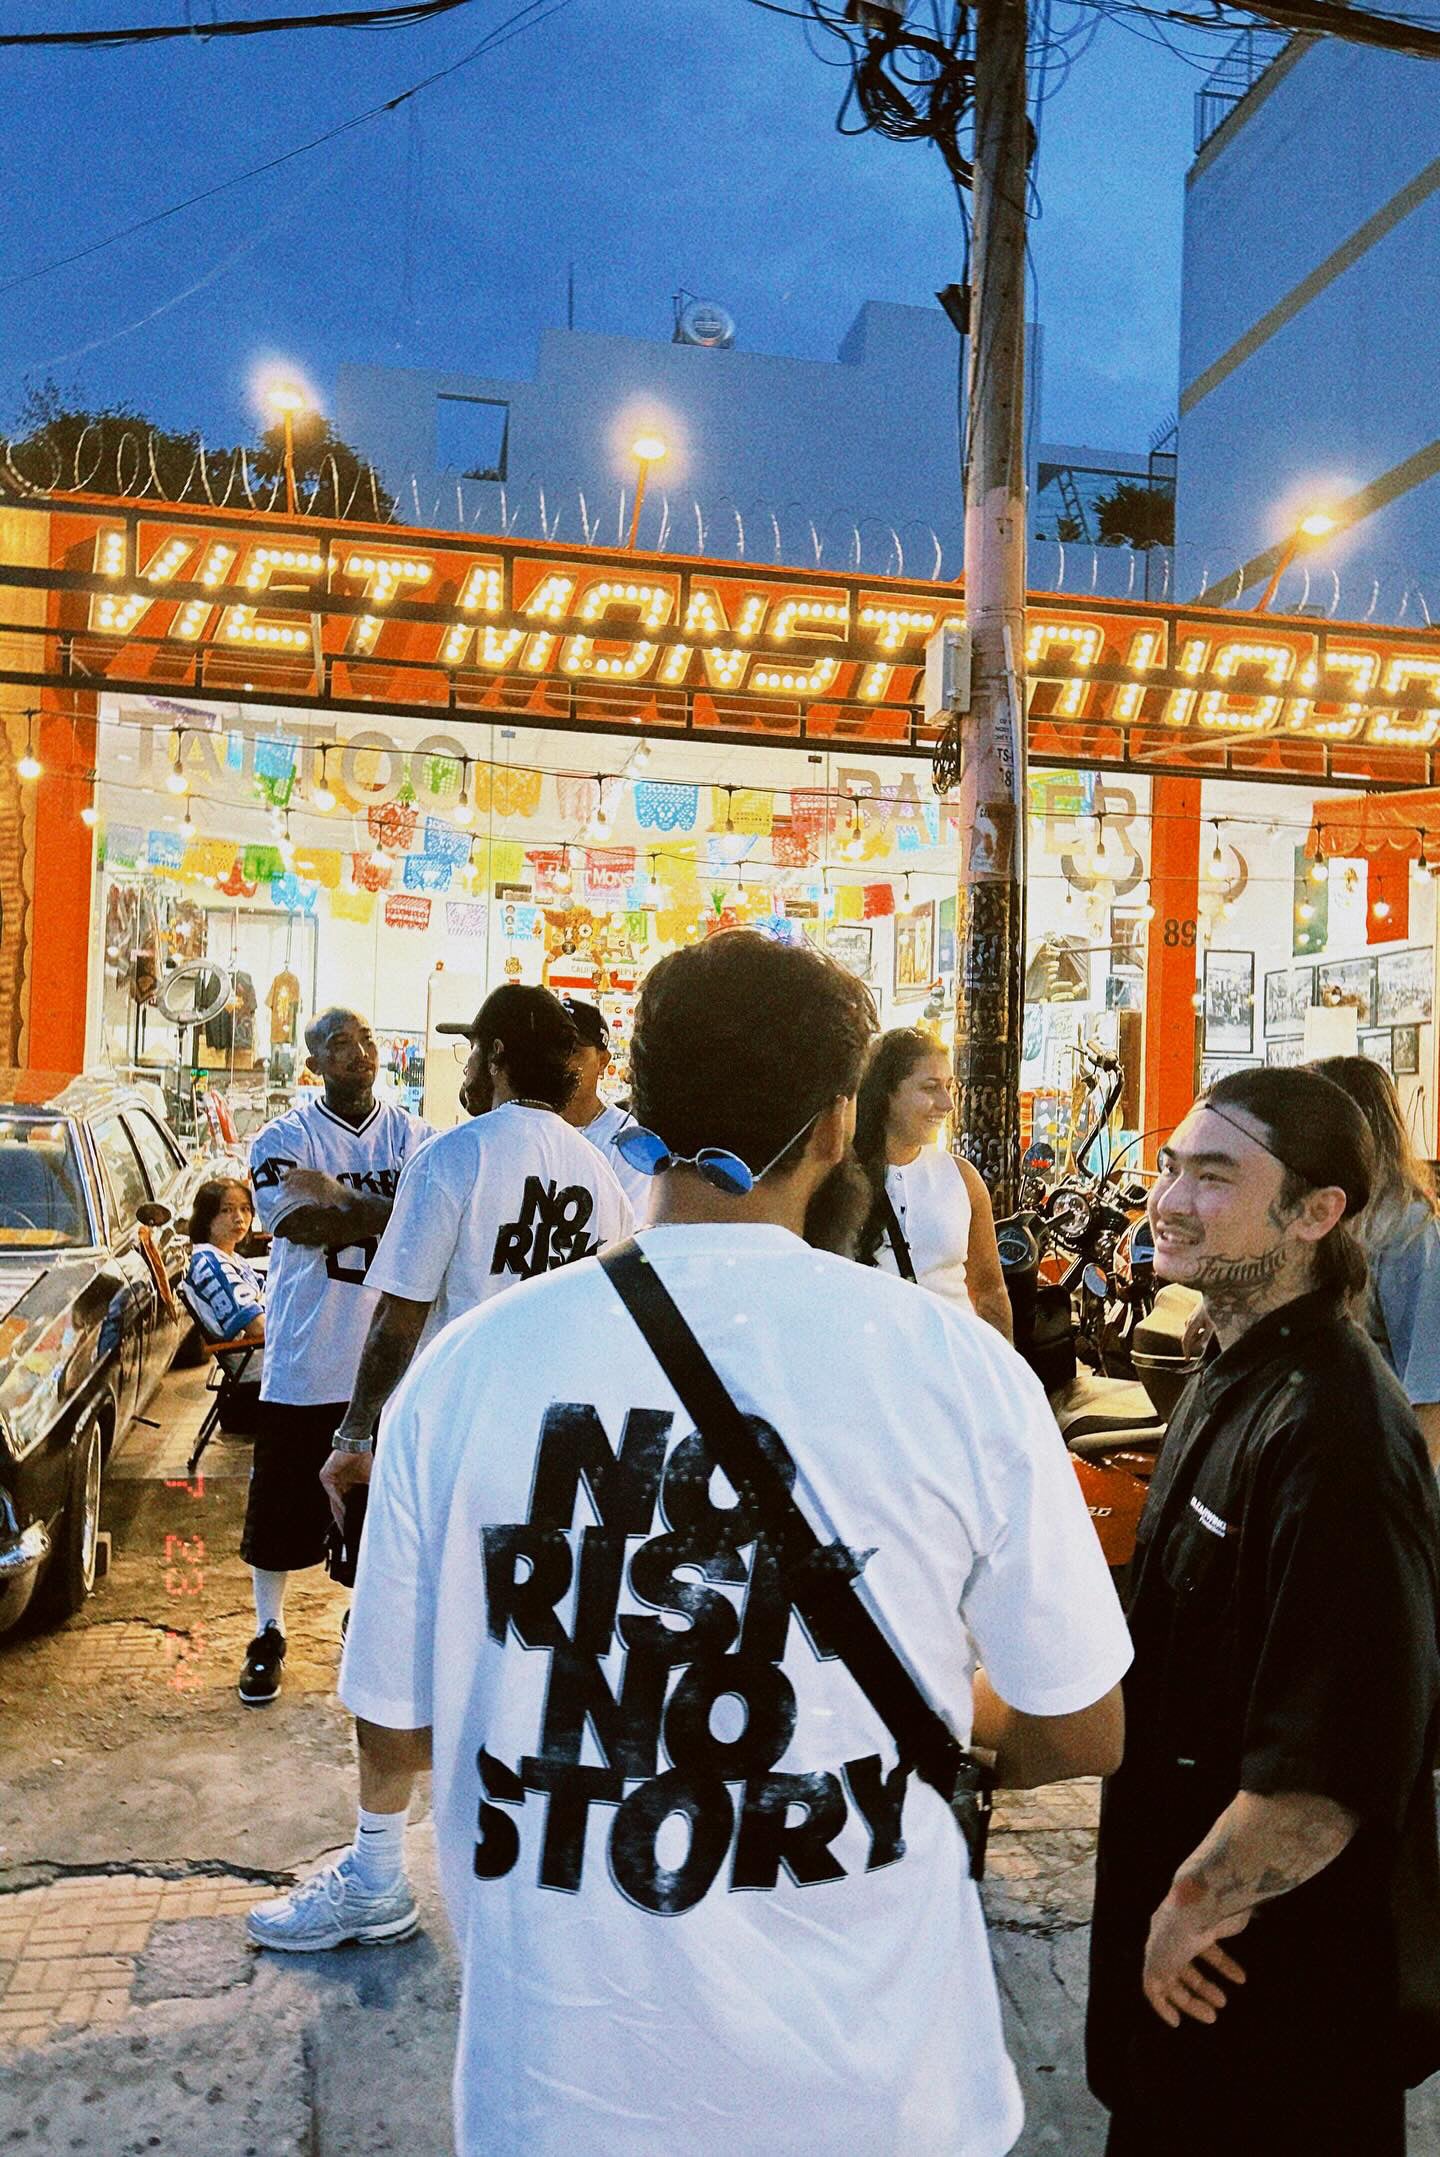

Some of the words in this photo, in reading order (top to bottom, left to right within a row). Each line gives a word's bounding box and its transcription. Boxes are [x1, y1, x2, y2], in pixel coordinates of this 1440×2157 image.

[118, 706, 474, 808] TATTOO
[1163, 918, 1198, 948] 89
[518, 1175, 594, 1231] NO
[525, 1401, 798, 1537] NO
[535, 1644, 798, 1784] NO
[473, 1740, 909, 1918] STORY
